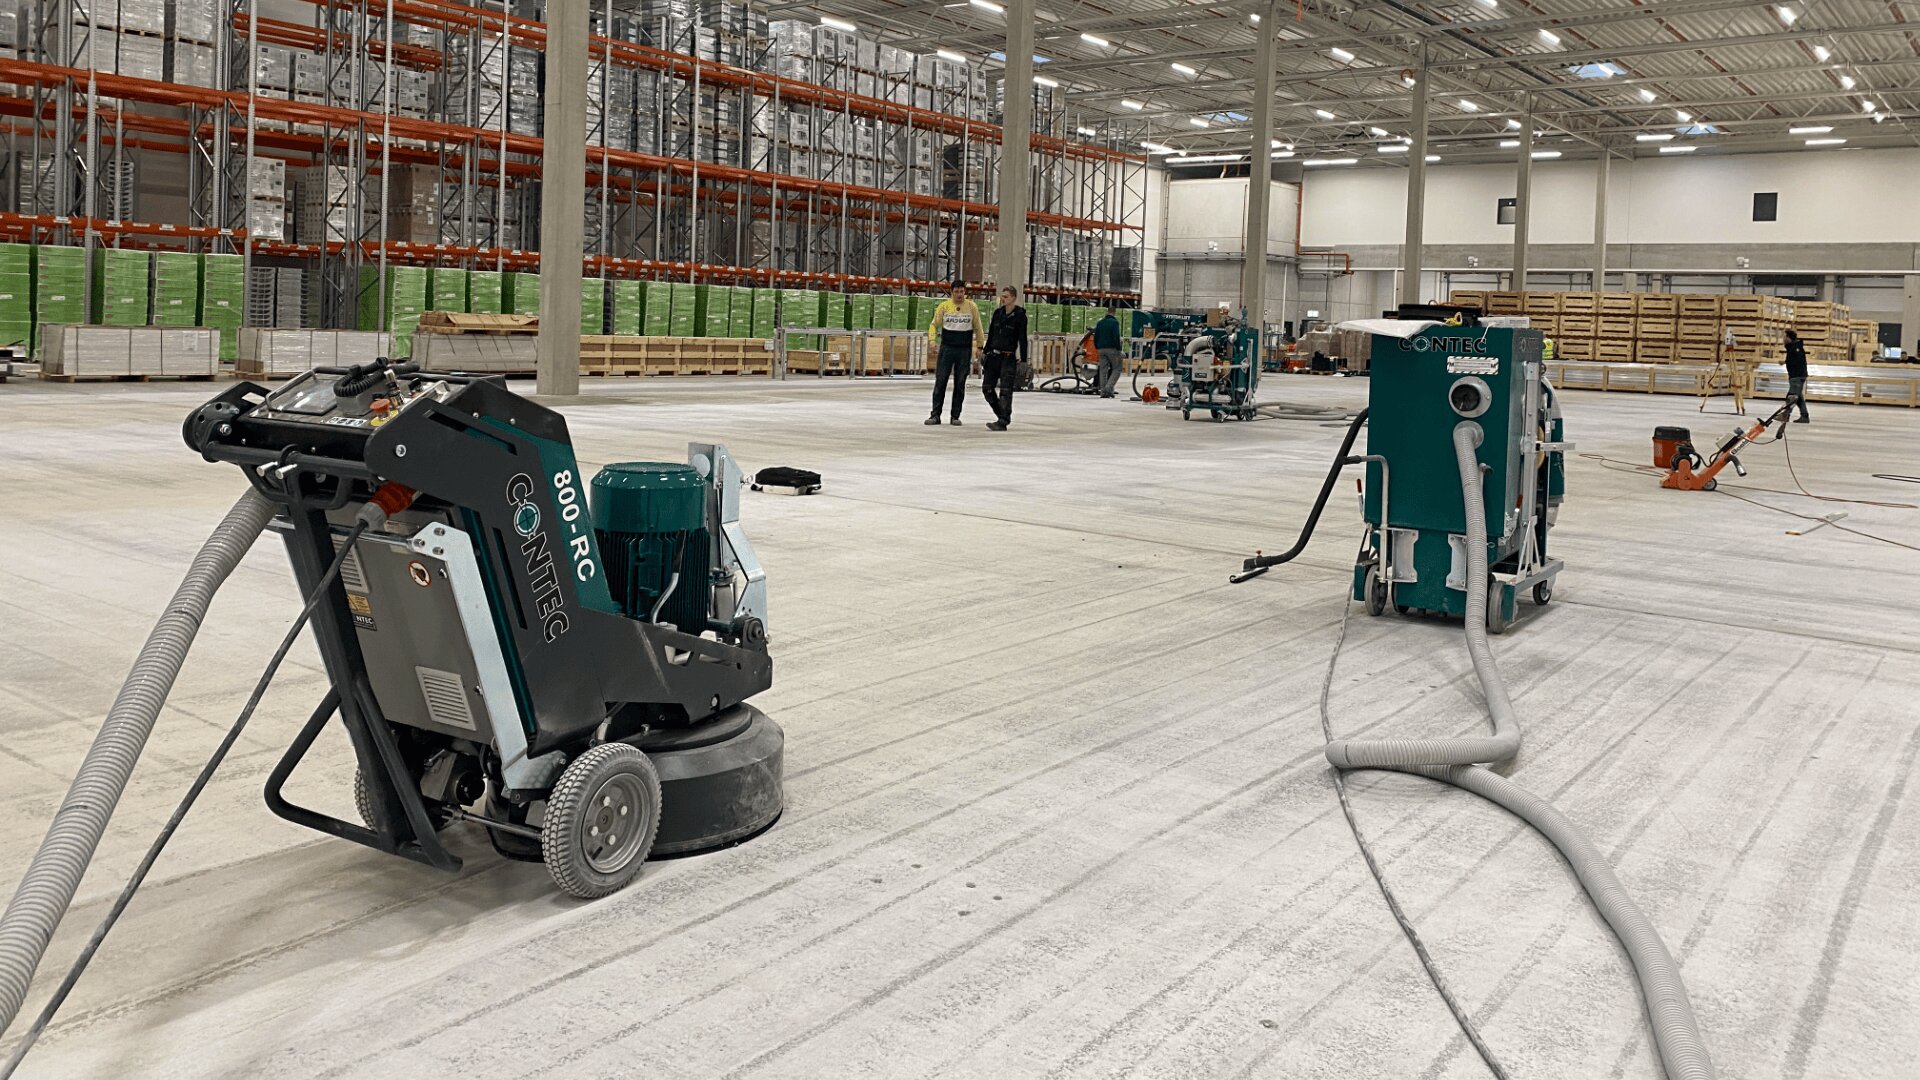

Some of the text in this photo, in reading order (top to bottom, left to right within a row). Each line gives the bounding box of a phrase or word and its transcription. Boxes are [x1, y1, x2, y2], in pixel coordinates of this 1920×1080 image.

[1398, 336, 1487, 354] CONTEC
[506, 472, 570, 643] CONTEC
[553, 469, 595, 582] 800-RC
